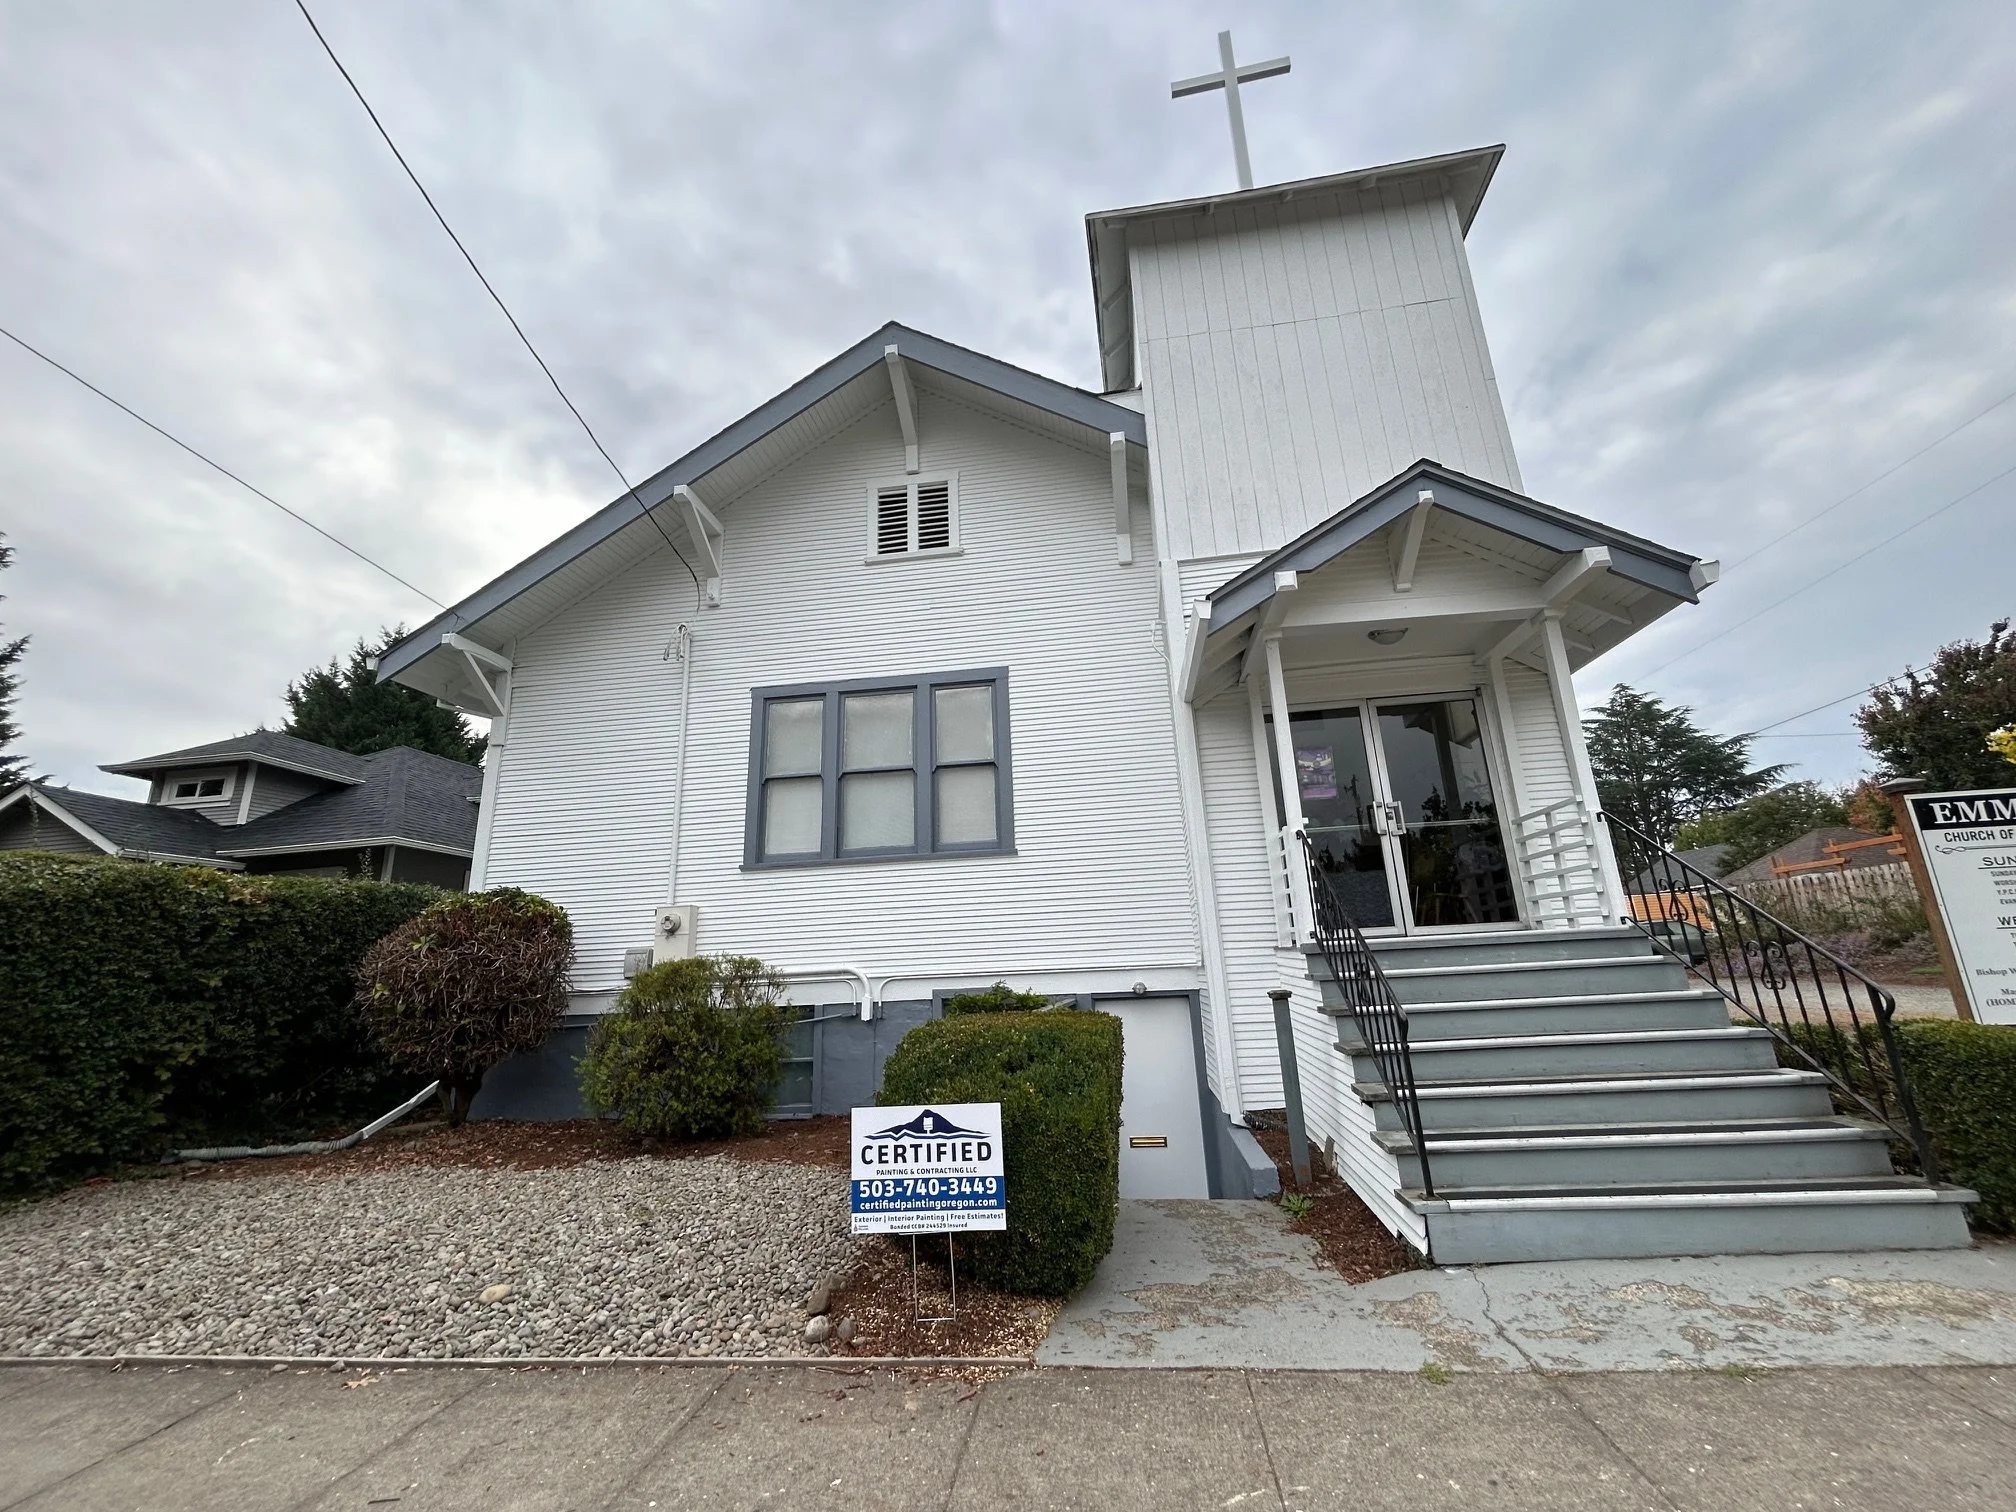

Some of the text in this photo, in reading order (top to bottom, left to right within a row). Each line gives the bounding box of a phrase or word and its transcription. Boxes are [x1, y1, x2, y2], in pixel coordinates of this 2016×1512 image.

[1928, 798, 2016, 824] EMM
[1944, 829, 2014, 842] CHURCH OF
[1976, 968, 2008, 976] Bishop
[860, 1141, 992, 1165] CERTIFIED
[876, 1168, 908, 1176] PAINTING
[859, 1177, 997, 1198] 503-740-3449
[859, 1198, 997, 1210] certifiedpaintingoregon.com
[916, 1213, 945, 1222] Painting
